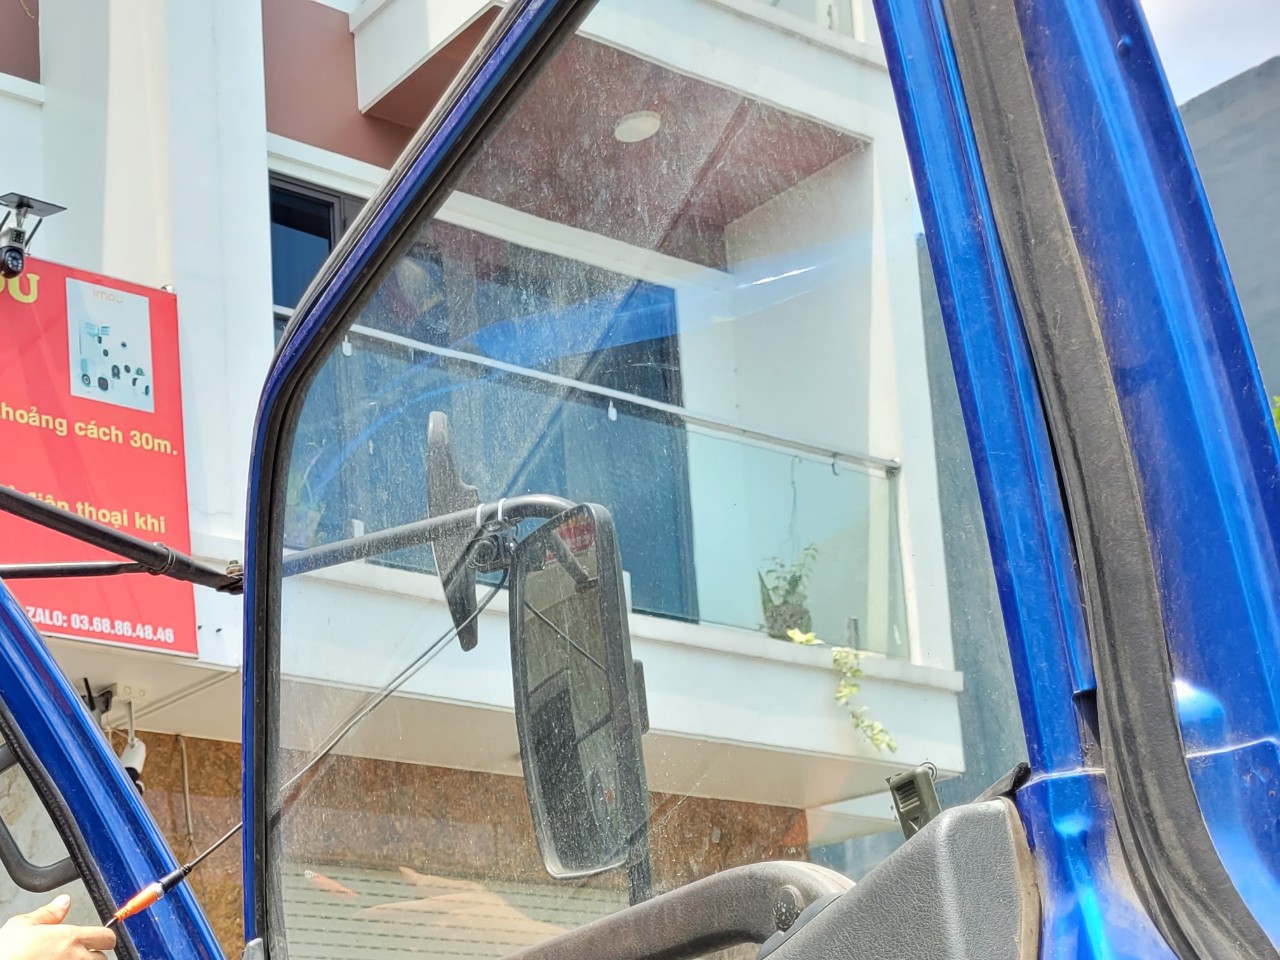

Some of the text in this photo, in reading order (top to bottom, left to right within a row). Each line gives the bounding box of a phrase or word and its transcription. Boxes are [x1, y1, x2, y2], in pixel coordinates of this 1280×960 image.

[74, 419, 123, 445] cách
[129, 429, 179, 456] 30m.
[75, 500, 129, 530] thoại
[134, 511, 167, 534] khi
[24, 605, 176, 644] ZALO: 03.68.86.48.46
